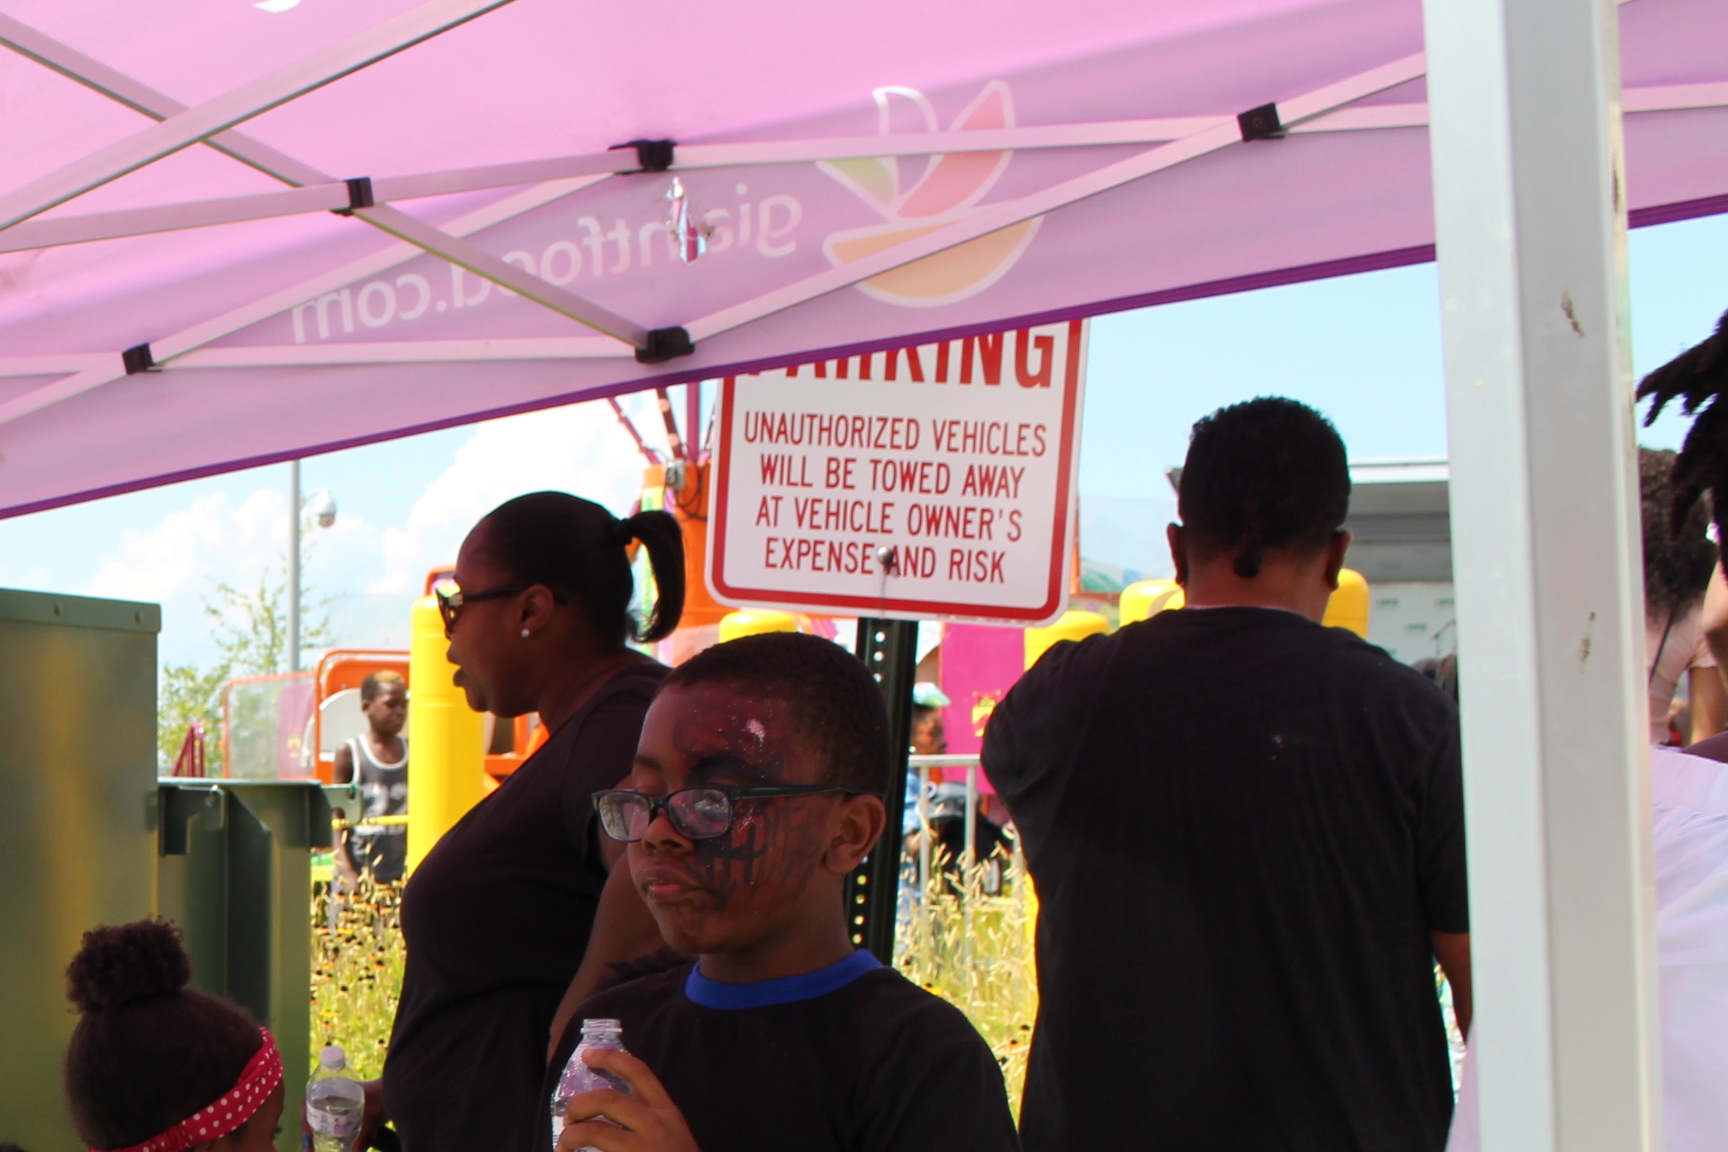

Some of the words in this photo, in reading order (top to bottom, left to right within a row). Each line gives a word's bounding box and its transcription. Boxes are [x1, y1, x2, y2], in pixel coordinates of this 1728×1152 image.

[744, 410, 920, 450] UNAUTHORIZED
[932, 419, 1047, 457] VEHICLES
[760, 454, 813, 488] WILL
[825, 457, 857, 490] BE
[870, 459, 951, 495] TOWED
[962, 464, 1026, 499] AWAY
[756, 495, 783, 527] AT
[795, 497, 895, 534] VEHICLE
[907, 504, 1023, 543] OWNER'S
[765, 537, 875, 575] EXPENSE
[886, 545, 936, 578] AND
[949, 551, 1005, 584] RISK
